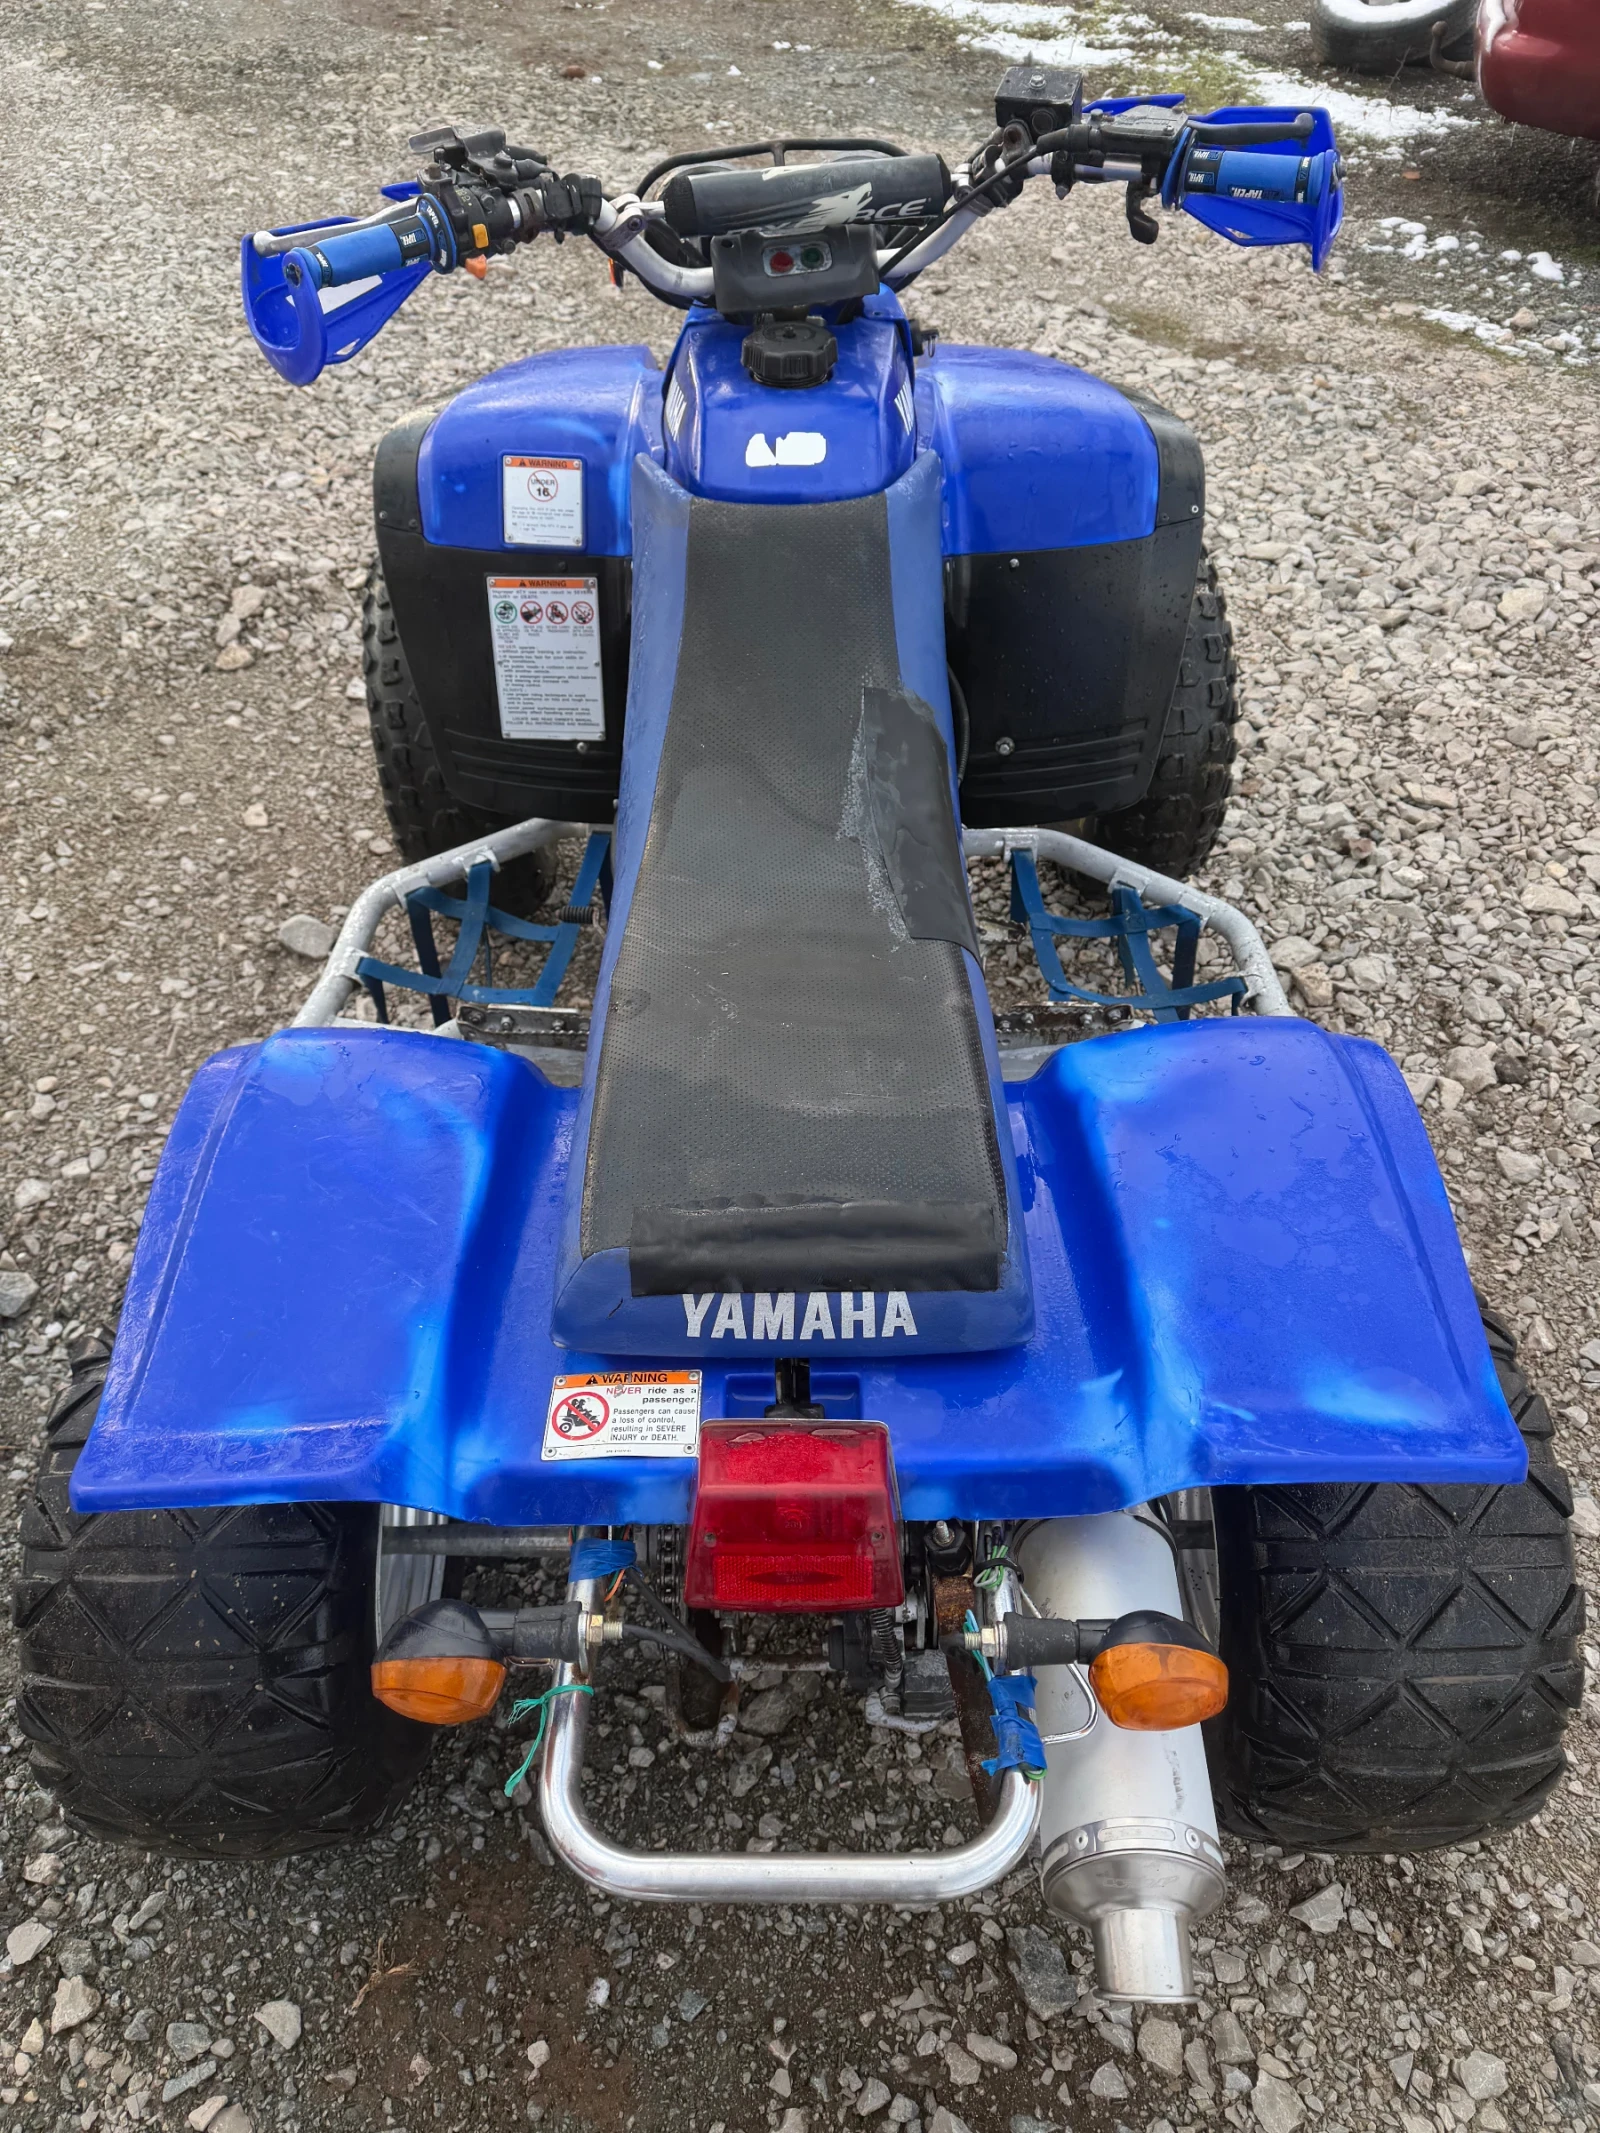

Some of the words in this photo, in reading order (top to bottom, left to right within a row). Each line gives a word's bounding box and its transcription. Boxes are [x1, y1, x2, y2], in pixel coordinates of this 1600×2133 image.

[528, 458, 567, 468] WARNING
[536, 487, 550, 497] 16
[682, 1291, 918, 1340] YAMAHA
[602, 1373, 668, 1383] WARNING
[606, 1387, 642, 1395] NEVER
[648, 1386, 667, 1394] ride
[642, 1396, 696, 1404] passenger.
[648, 1416, 676, 1424] control,
[611, 1425, 643, 1433] resulting
